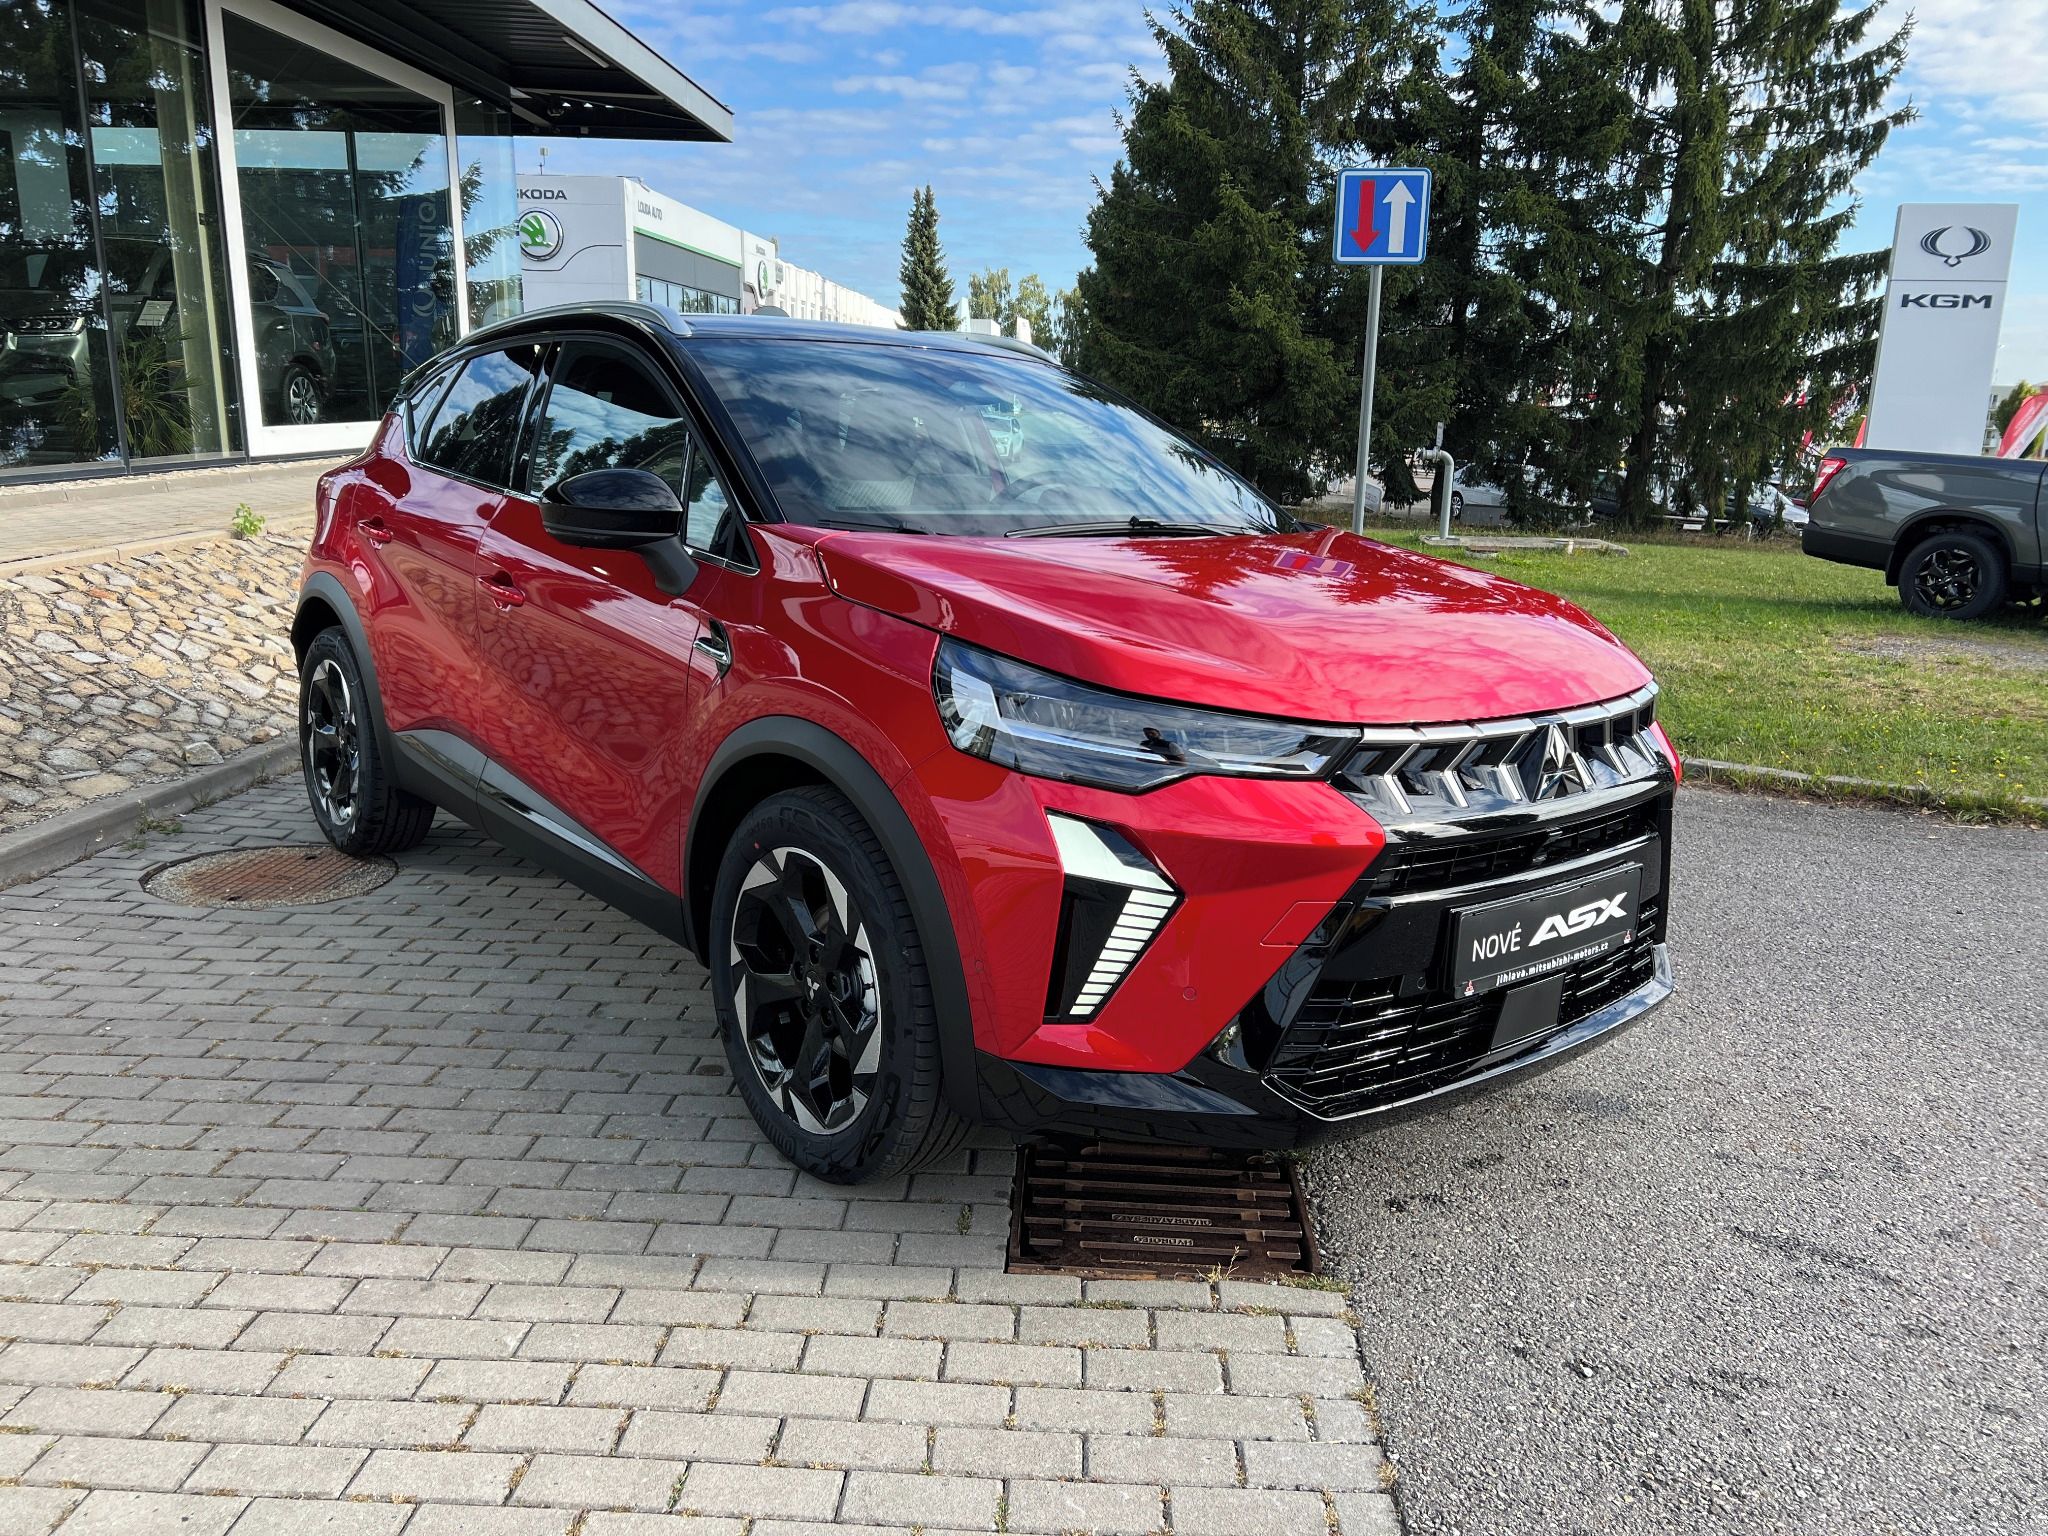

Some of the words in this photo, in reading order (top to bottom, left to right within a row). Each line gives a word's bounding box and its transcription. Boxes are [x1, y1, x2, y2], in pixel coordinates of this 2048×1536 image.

[652, 205, 663, 220] AUTO
[1901, 293, 1993, 309] KGM
[1472, 921, 1522, 962] NOVÉ
[1528, 892, 1627, 947] ASX
[1496, 942, 1609, 986] jihlava.mitsubishi-motors.cz
